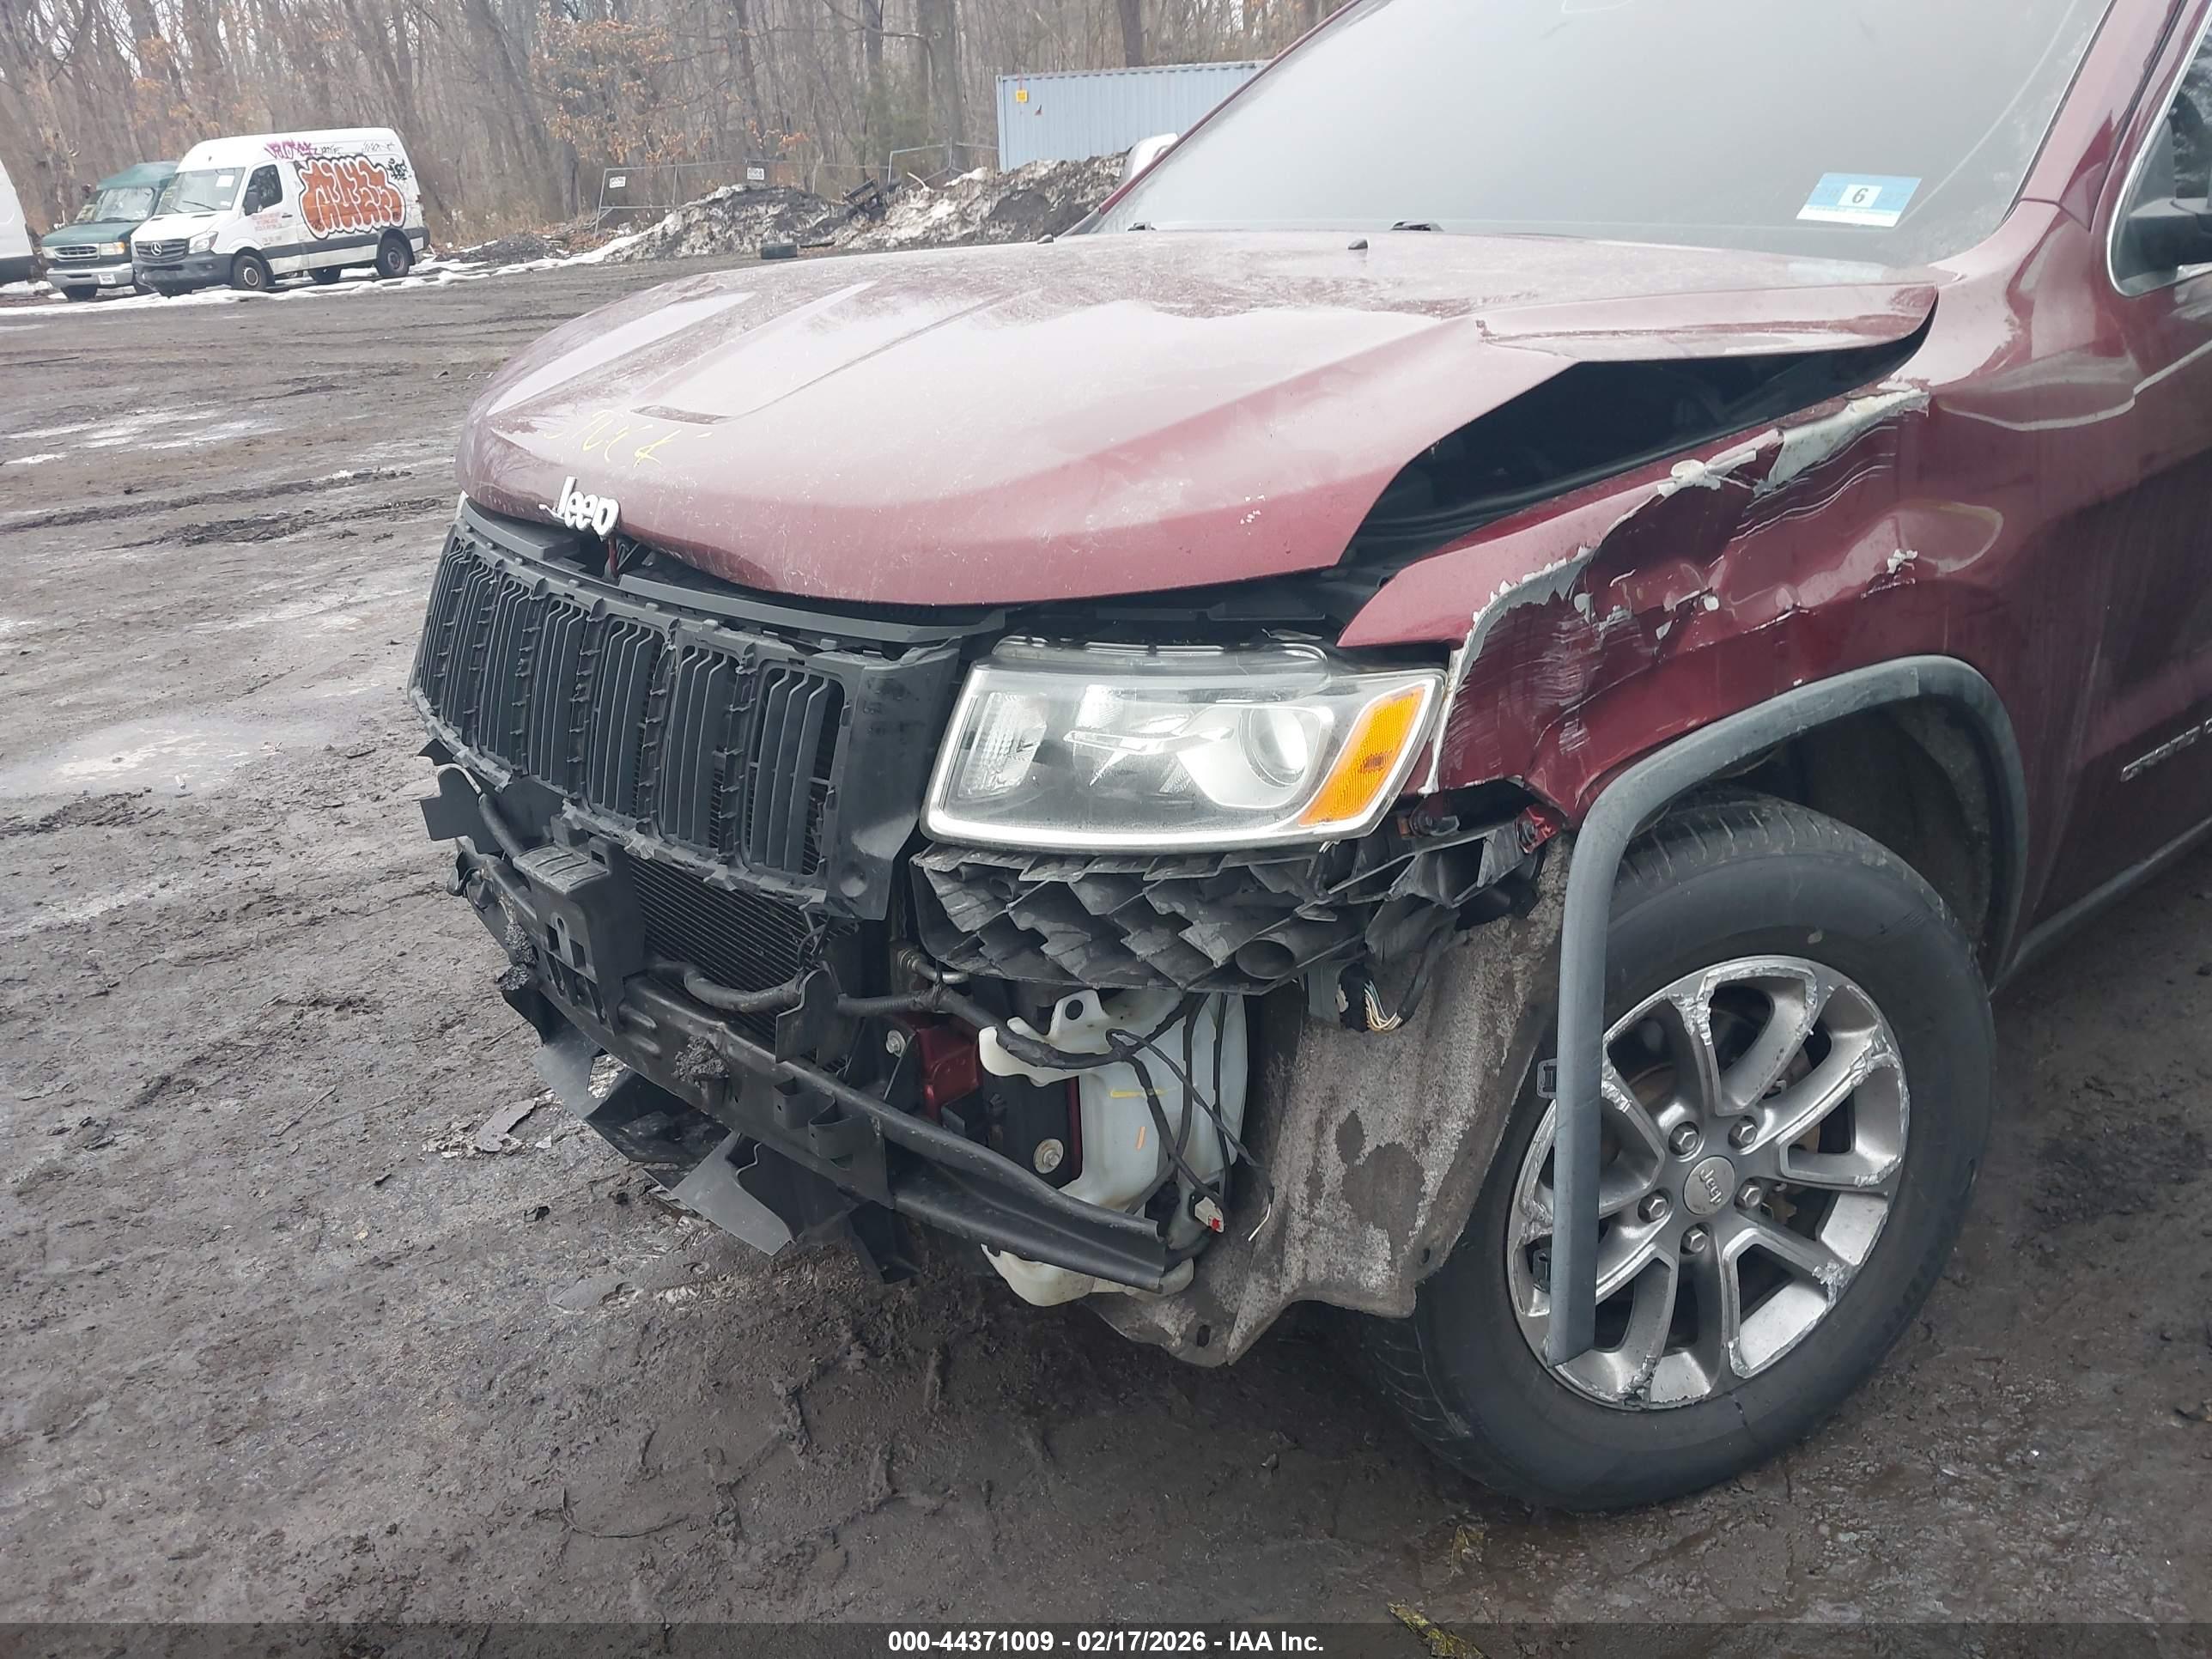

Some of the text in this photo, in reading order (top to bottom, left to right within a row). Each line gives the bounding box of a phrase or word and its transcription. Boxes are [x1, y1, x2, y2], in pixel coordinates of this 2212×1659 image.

[1851, 187, 1869, 204] 6
[538, 475, 620, 540] Jeep
[1699, 1168, 1724, 1205] Jeep
